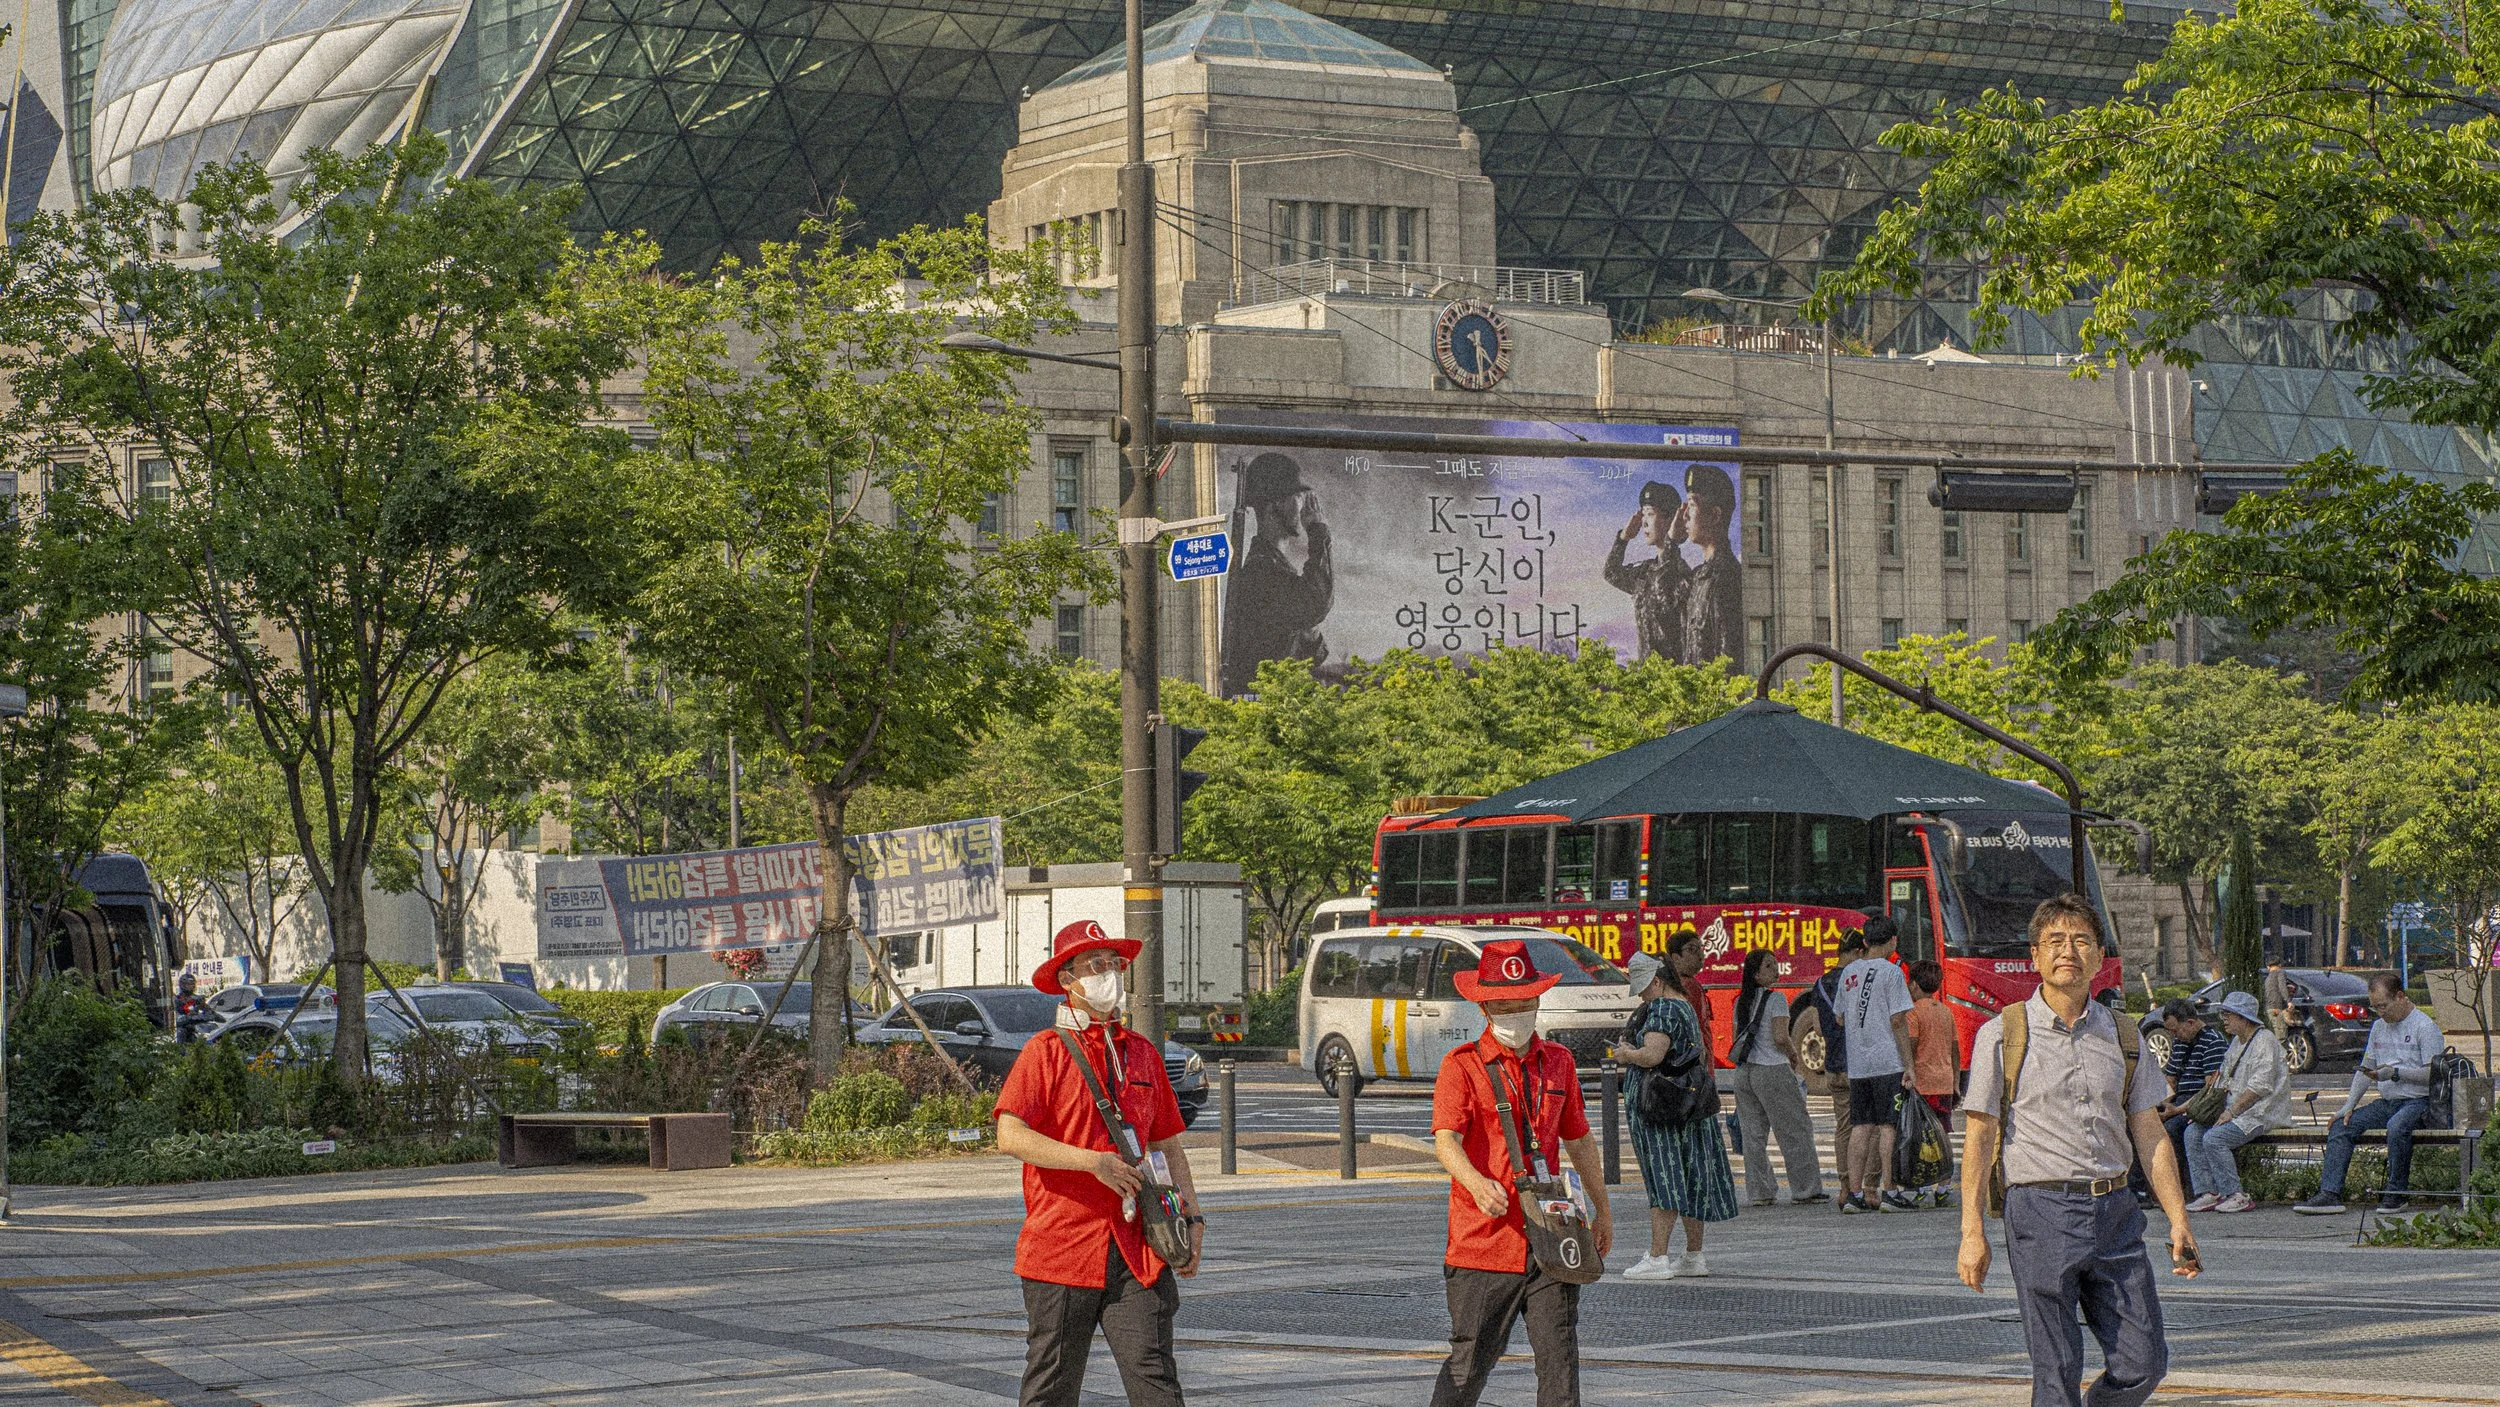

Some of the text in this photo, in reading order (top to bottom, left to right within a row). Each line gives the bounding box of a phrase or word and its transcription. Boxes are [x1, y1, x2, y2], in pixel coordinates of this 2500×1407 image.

[1344, 456, 1634, 485] 1950 그때도 지금도 2024
[1428, 493, 1556, 547] K-군인,
[1186, 539, 1213, 554] 세종대로
[1218, 548, 1226, 558] 95
[1432, 546, 1544, 598] 당신이
[1395, 601, 1588, 653] 영웅입니다
[1982, 836, 2003, 848] BUS
[2031, 836, 2061, 849] 타이거
[1733, 917, 1842, 956] 타이거 버스
[201, 961, 224, 976] 안내문
[1993, 961, 2029, 973] SEOUL
